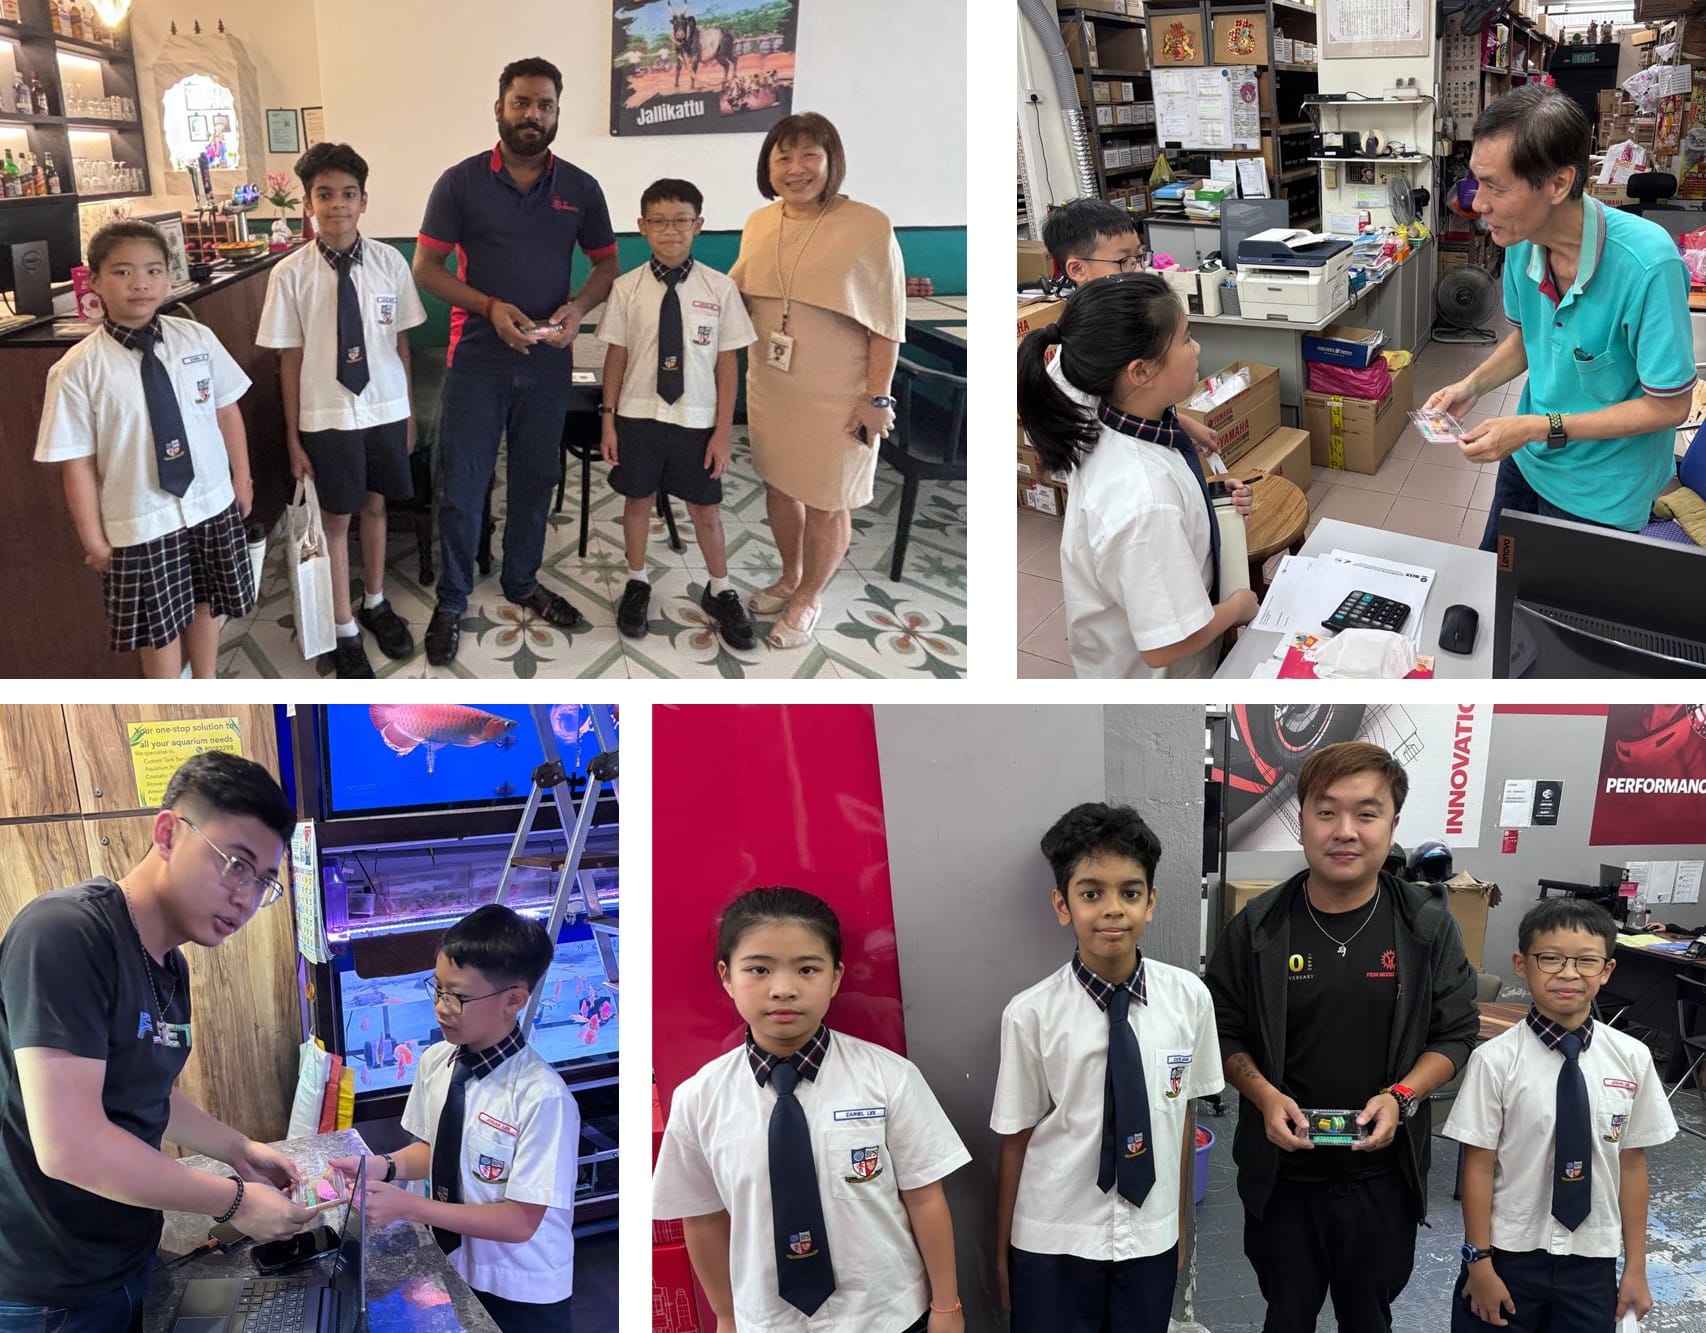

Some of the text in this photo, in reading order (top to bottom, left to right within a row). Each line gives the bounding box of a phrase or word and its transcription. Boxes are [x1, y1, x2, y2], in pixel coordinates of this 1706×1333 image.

[636, 100, 705, 126] Jallikattu
[1212, 407, 1233, 425] YAMAHA
[1219, 418, 1250, 448] YAMAHA
[1502, 538, 1511, 569] Lenovo
[155, 725, 191, 734] one-stop
[193, 723, 224, 732] solution
[140, 735, 233, 750] all your aquarium needs
